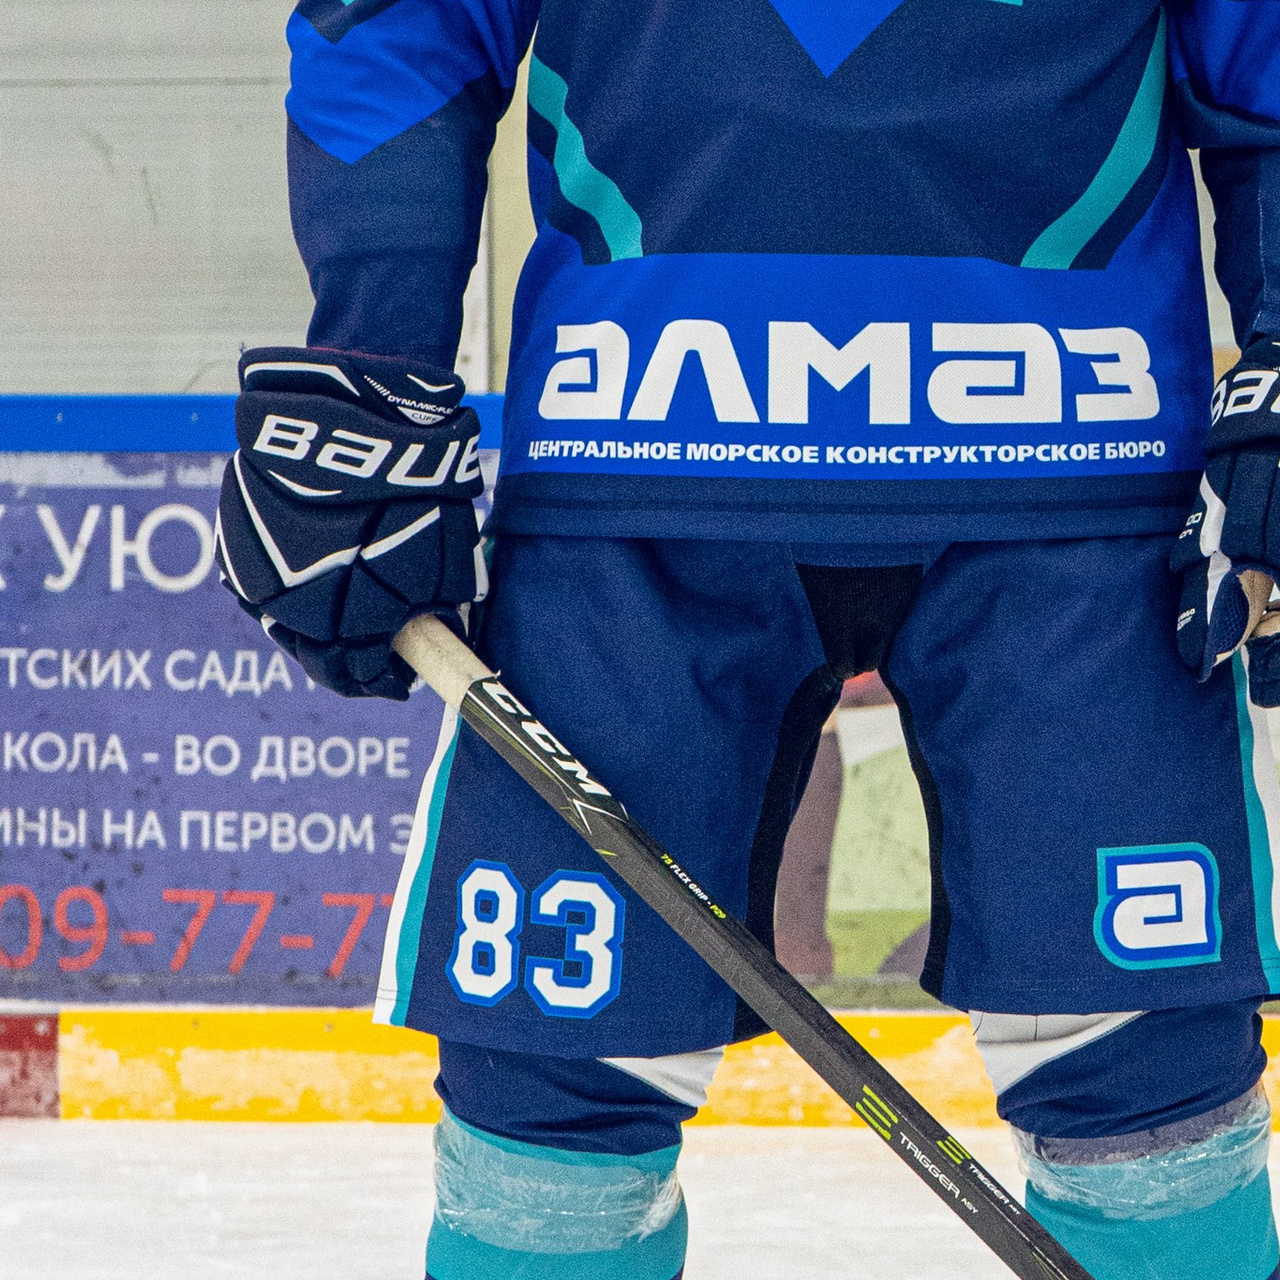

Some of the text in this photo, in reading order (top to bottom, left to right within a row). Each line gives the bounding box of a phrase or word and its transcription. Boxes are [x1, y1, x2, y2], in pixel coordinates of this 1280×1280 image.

[527, 439, 1166, 464] ЦЕНТРАЛЬНОЕ МОРСКОЕ КОНСТРУКТОРСКОЕ БЮРО
[3, 731, 129, 773] КОЛА
[174, 734, 241, 777] ВО
[250, 735, 411, 783] ДВОРЕ
[481, 681, 612, 797] CCM
[102, 809, 167, 850] НА
[180, 810, 374, 855] ПЕРВОМ
[670, 864, 692, 884] FLEX
[688, 883, 709, 901] GRIP
[452, 866, 617, 1010] 83
[900, 1131, 961, 1199] TRIGGER
[967, 1162, 1010, 1205] TRIGGER
